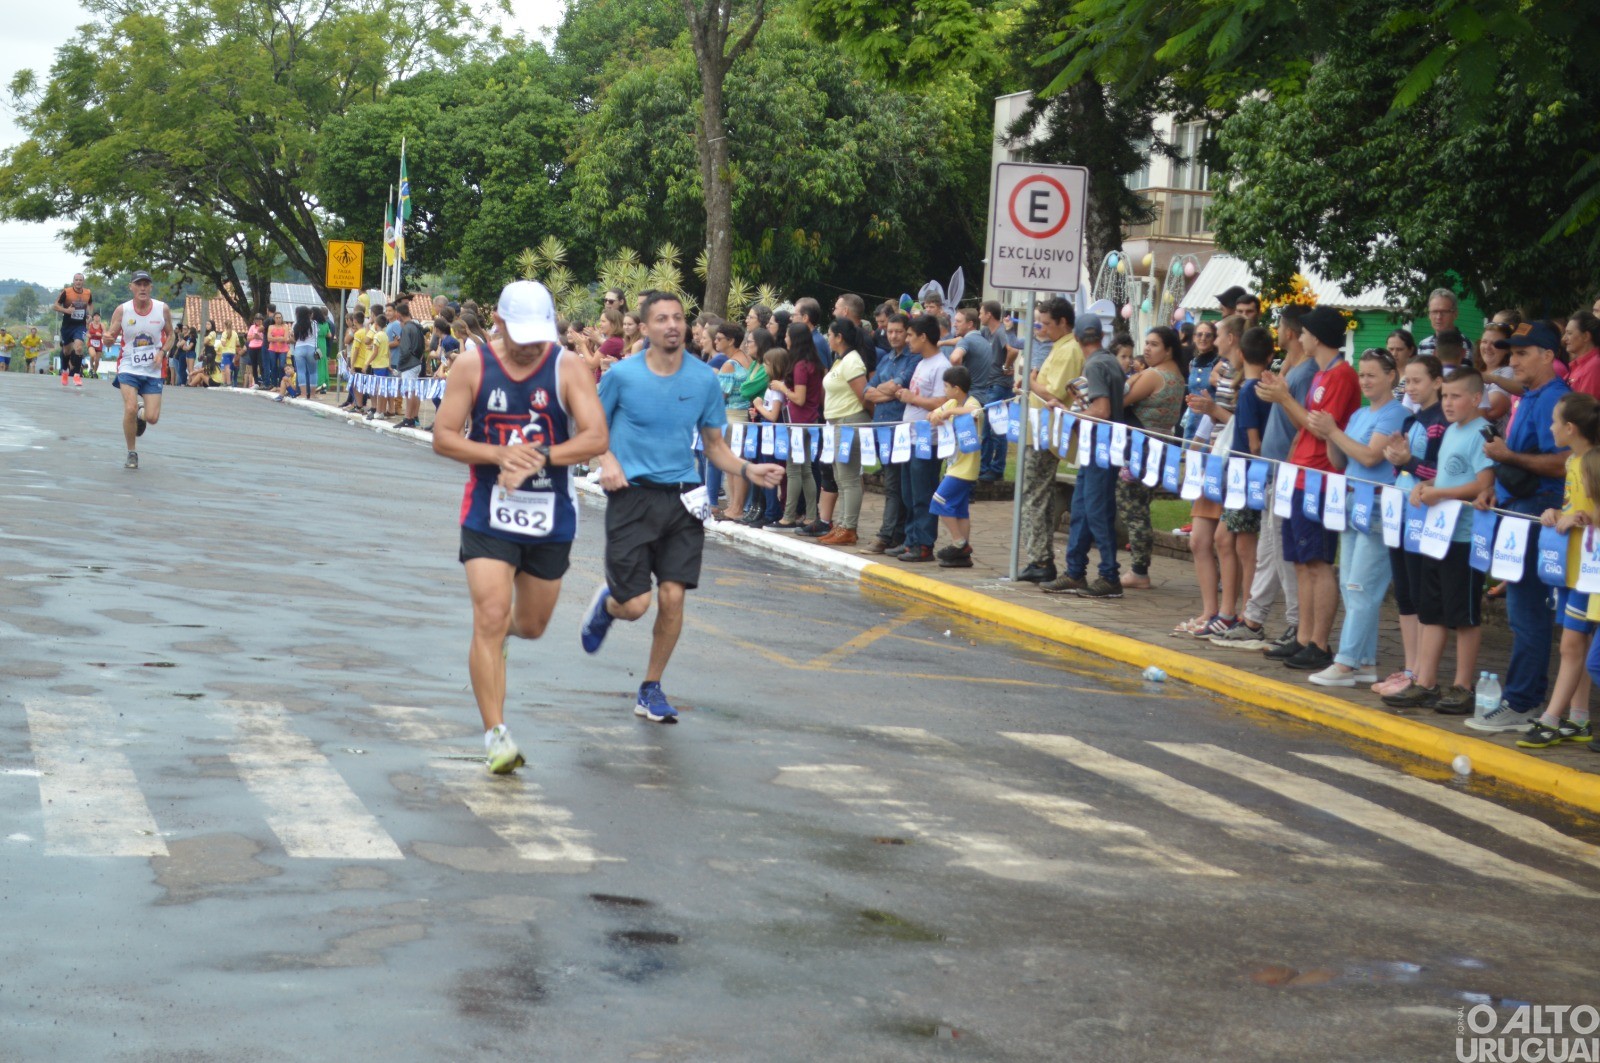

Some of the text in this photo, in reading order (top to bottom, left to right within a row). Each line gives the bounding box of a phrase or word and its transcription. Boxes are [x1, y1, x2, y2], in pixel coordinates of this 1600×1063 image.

[1028, 189, 1050, 224] E
[998, 245, 1074, 262] EXCLUSIVO
[1021, 262, 1050, 279] TÁXI
[133, 352, 155, 363] 644
[495, 506, 548, 531] 662
[1494, 549, 1522, 564] Banrisul
